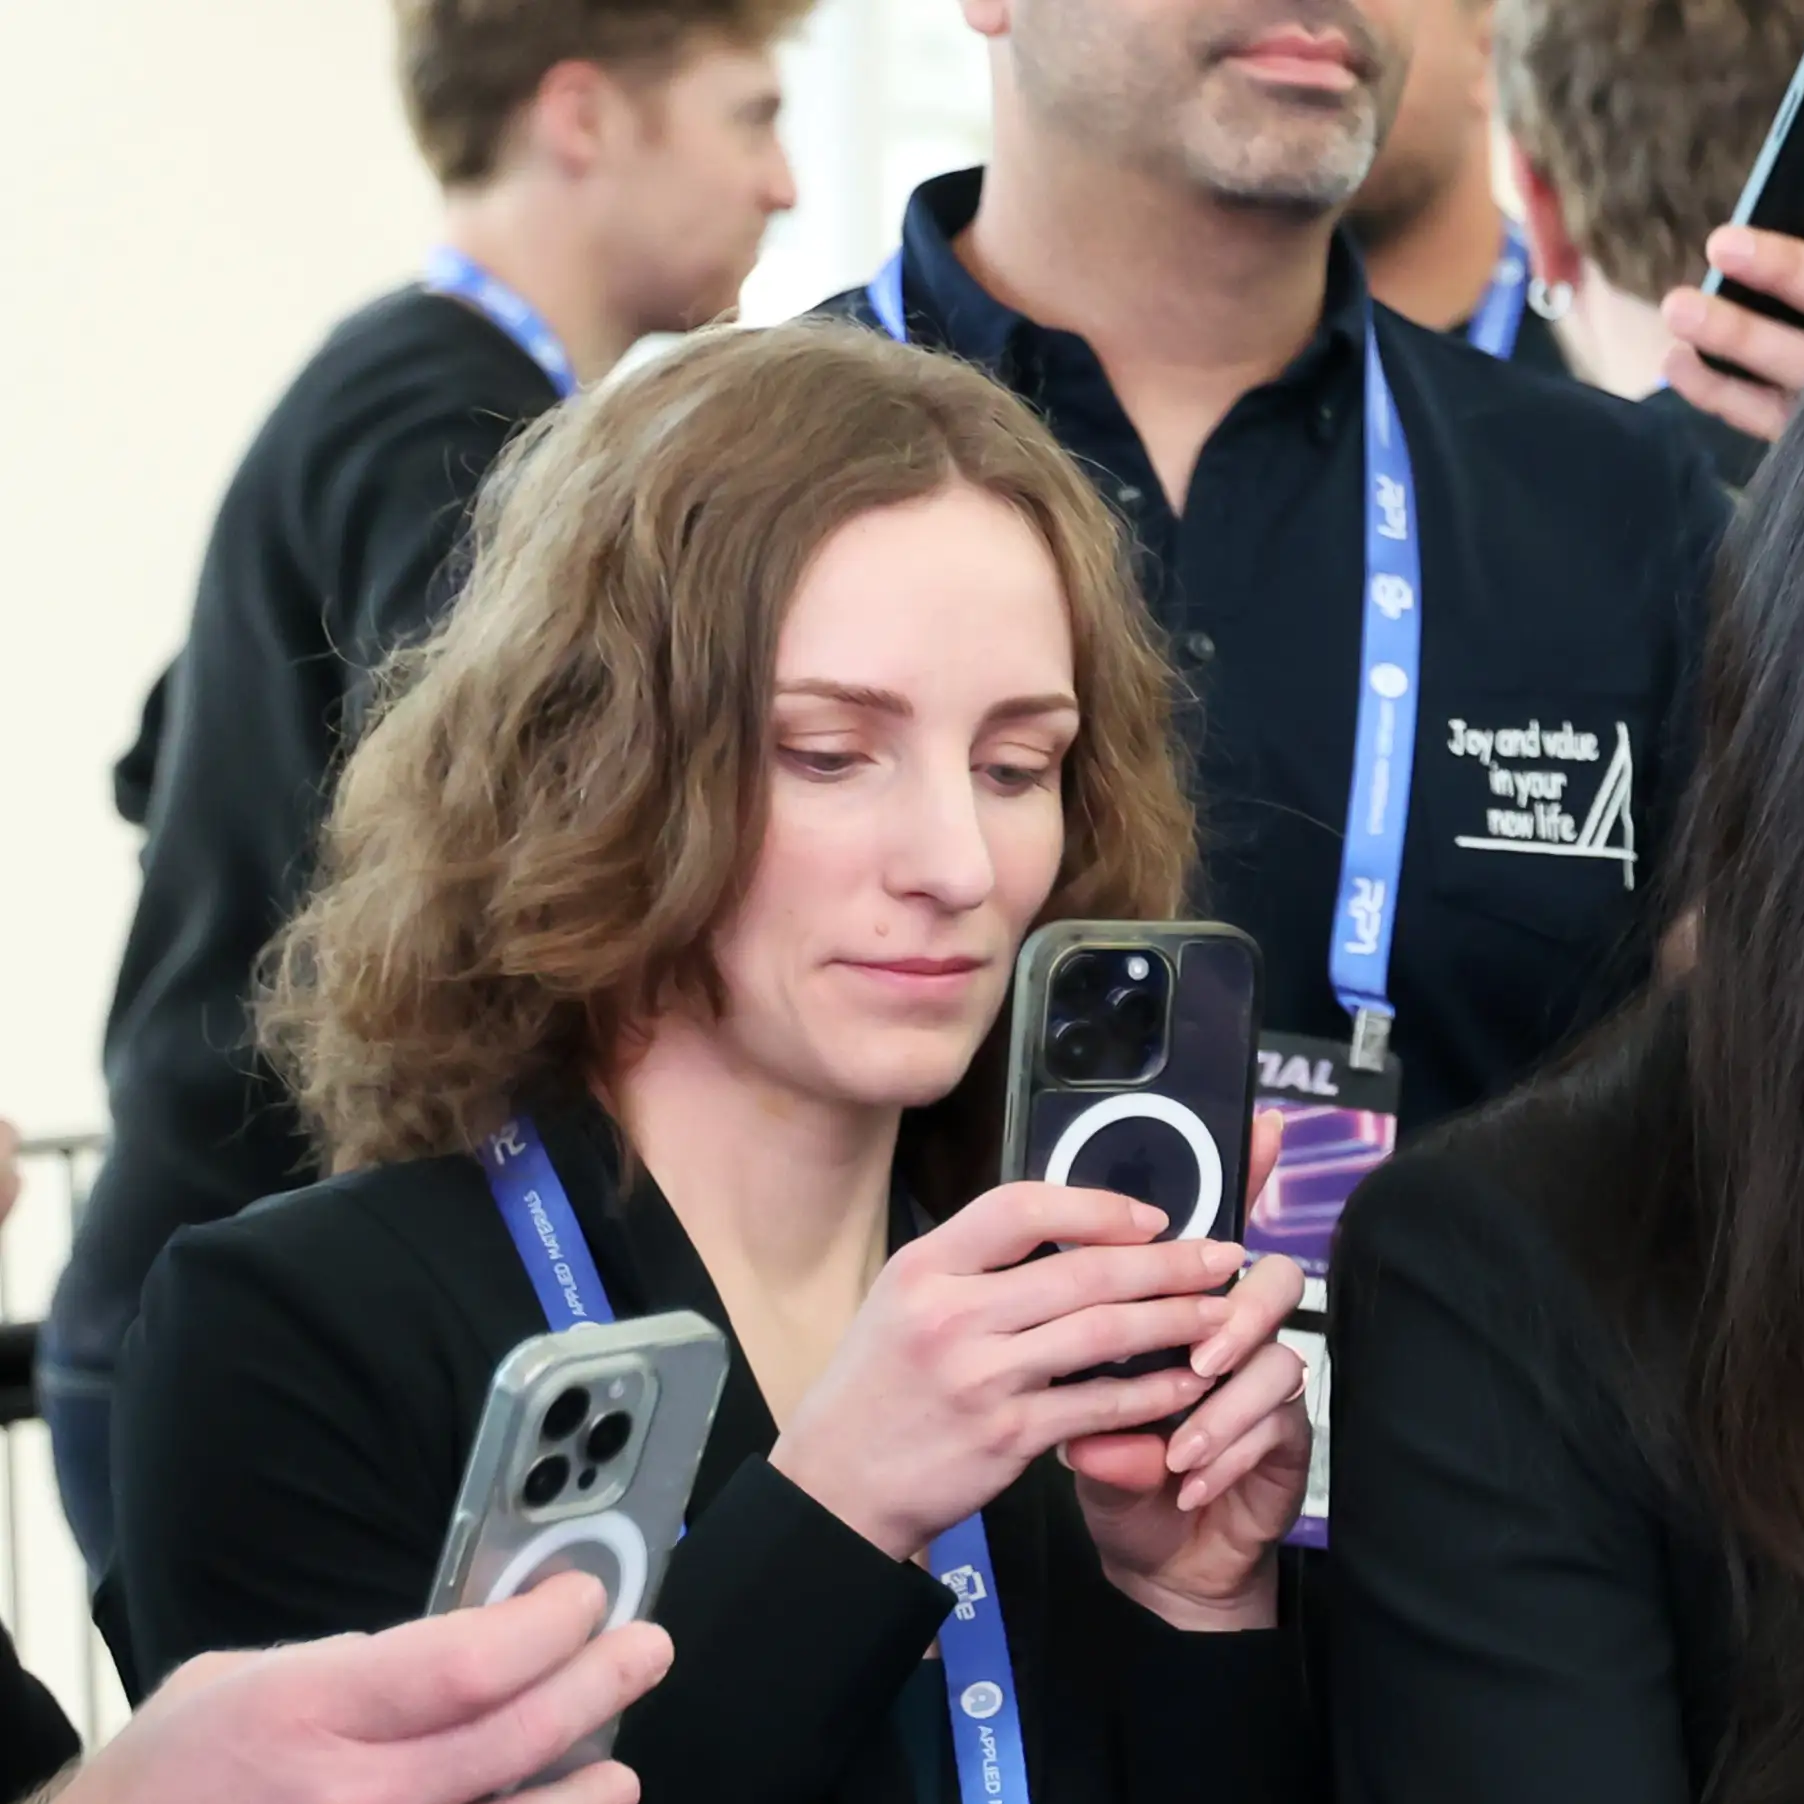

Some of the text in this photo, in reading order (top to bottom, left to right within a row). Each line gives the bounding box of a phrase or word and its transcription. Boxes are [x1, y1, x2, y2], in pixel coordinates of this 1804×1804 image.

[1447, 718, 1600, 766] Joy and value
[1489, 760, 1568, 808] in your
[1486, 802, 1578, 843] new life
[523, 1189, 587, 1318] APPLIED MATERIALS
[977, 1725, 1001, 1794] APPLIED
